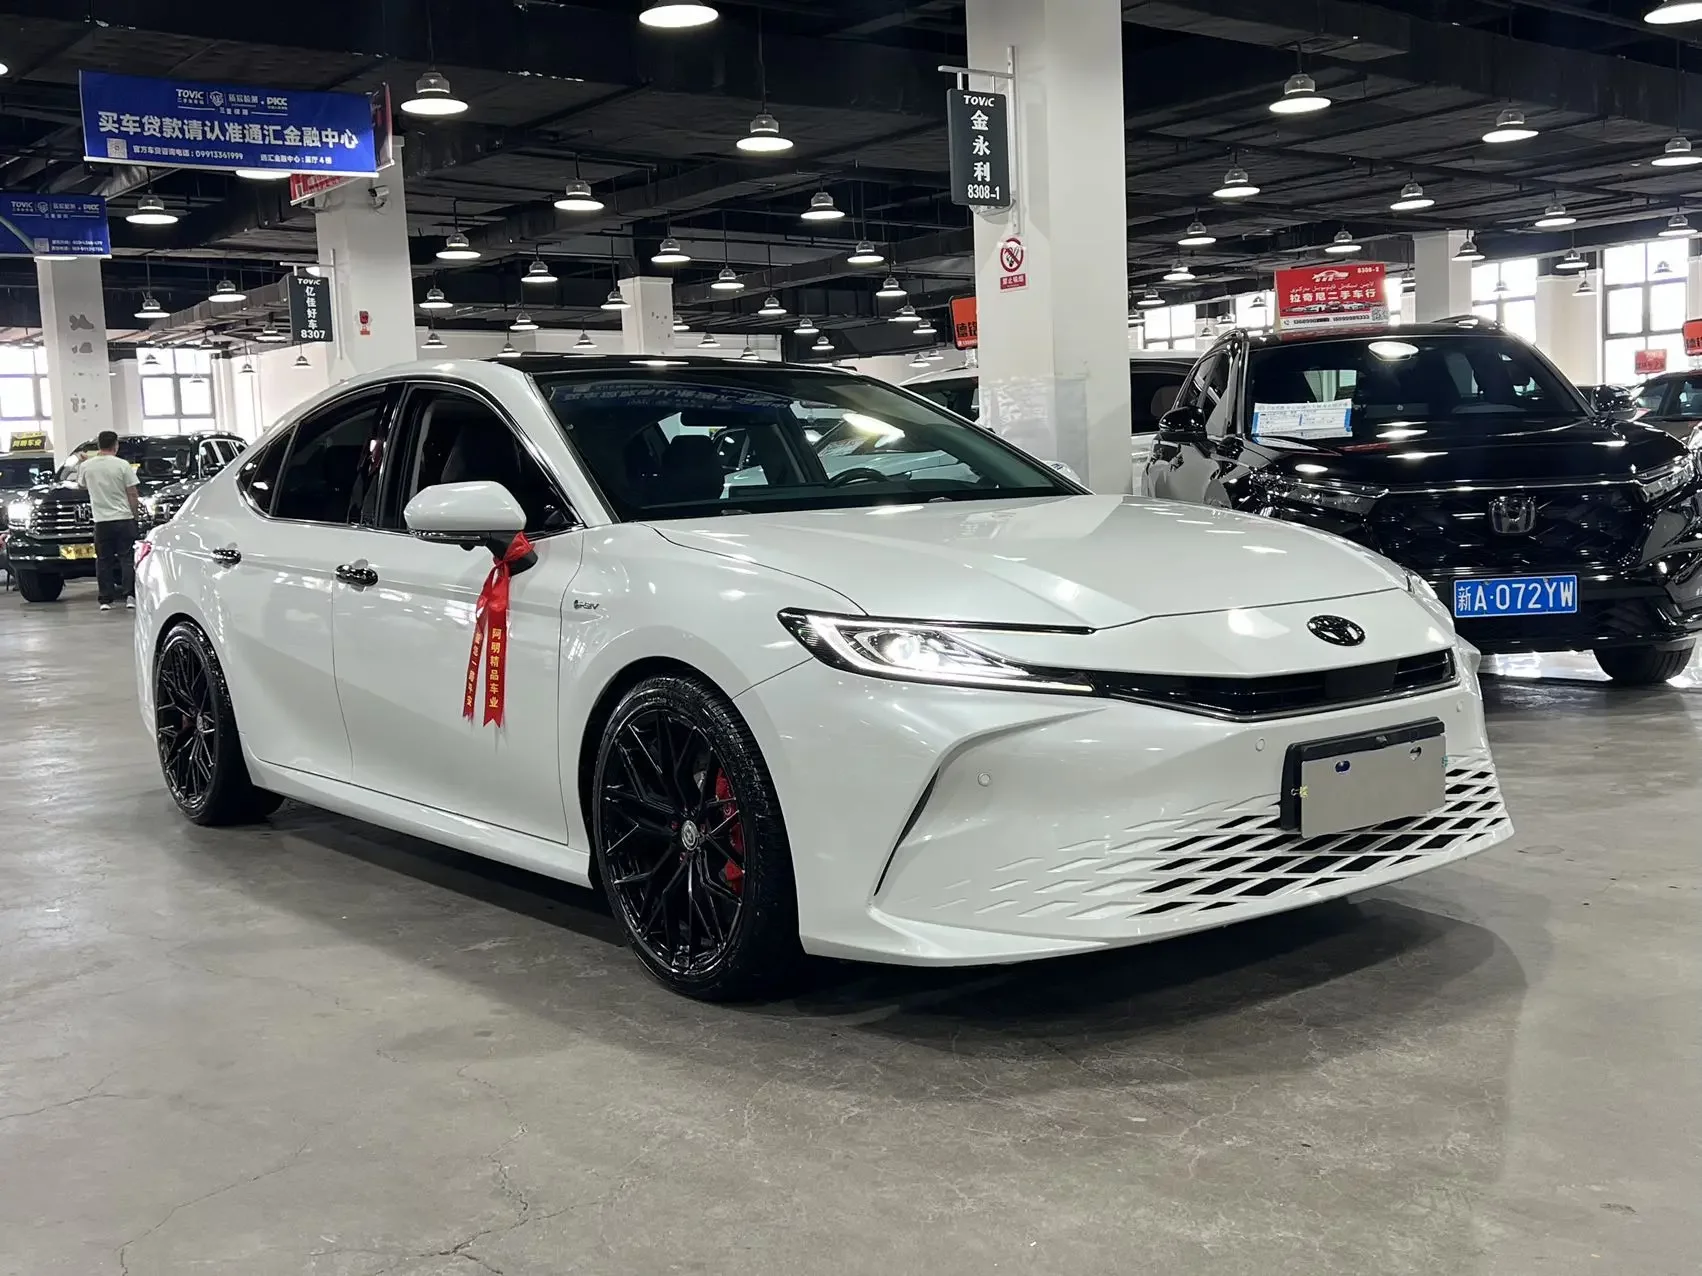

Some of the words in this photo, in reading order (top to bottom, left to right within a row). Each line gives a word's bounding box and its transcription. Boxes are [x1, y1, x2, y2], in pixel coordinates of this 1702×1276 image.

[97, 110, 359, 150] 买车贷款请认准通汇金融中心
[970, 110, 991, 182] 金永利
[967, 183, 1000, 200] 8308-1
[305, 285, 318, 330] 亿佳好车
[300, 329, 326, 339] 8307
[1457, 581, 1574, 612] 新A·072YW
[488, 627, 502, 708] 阿明精品车业
